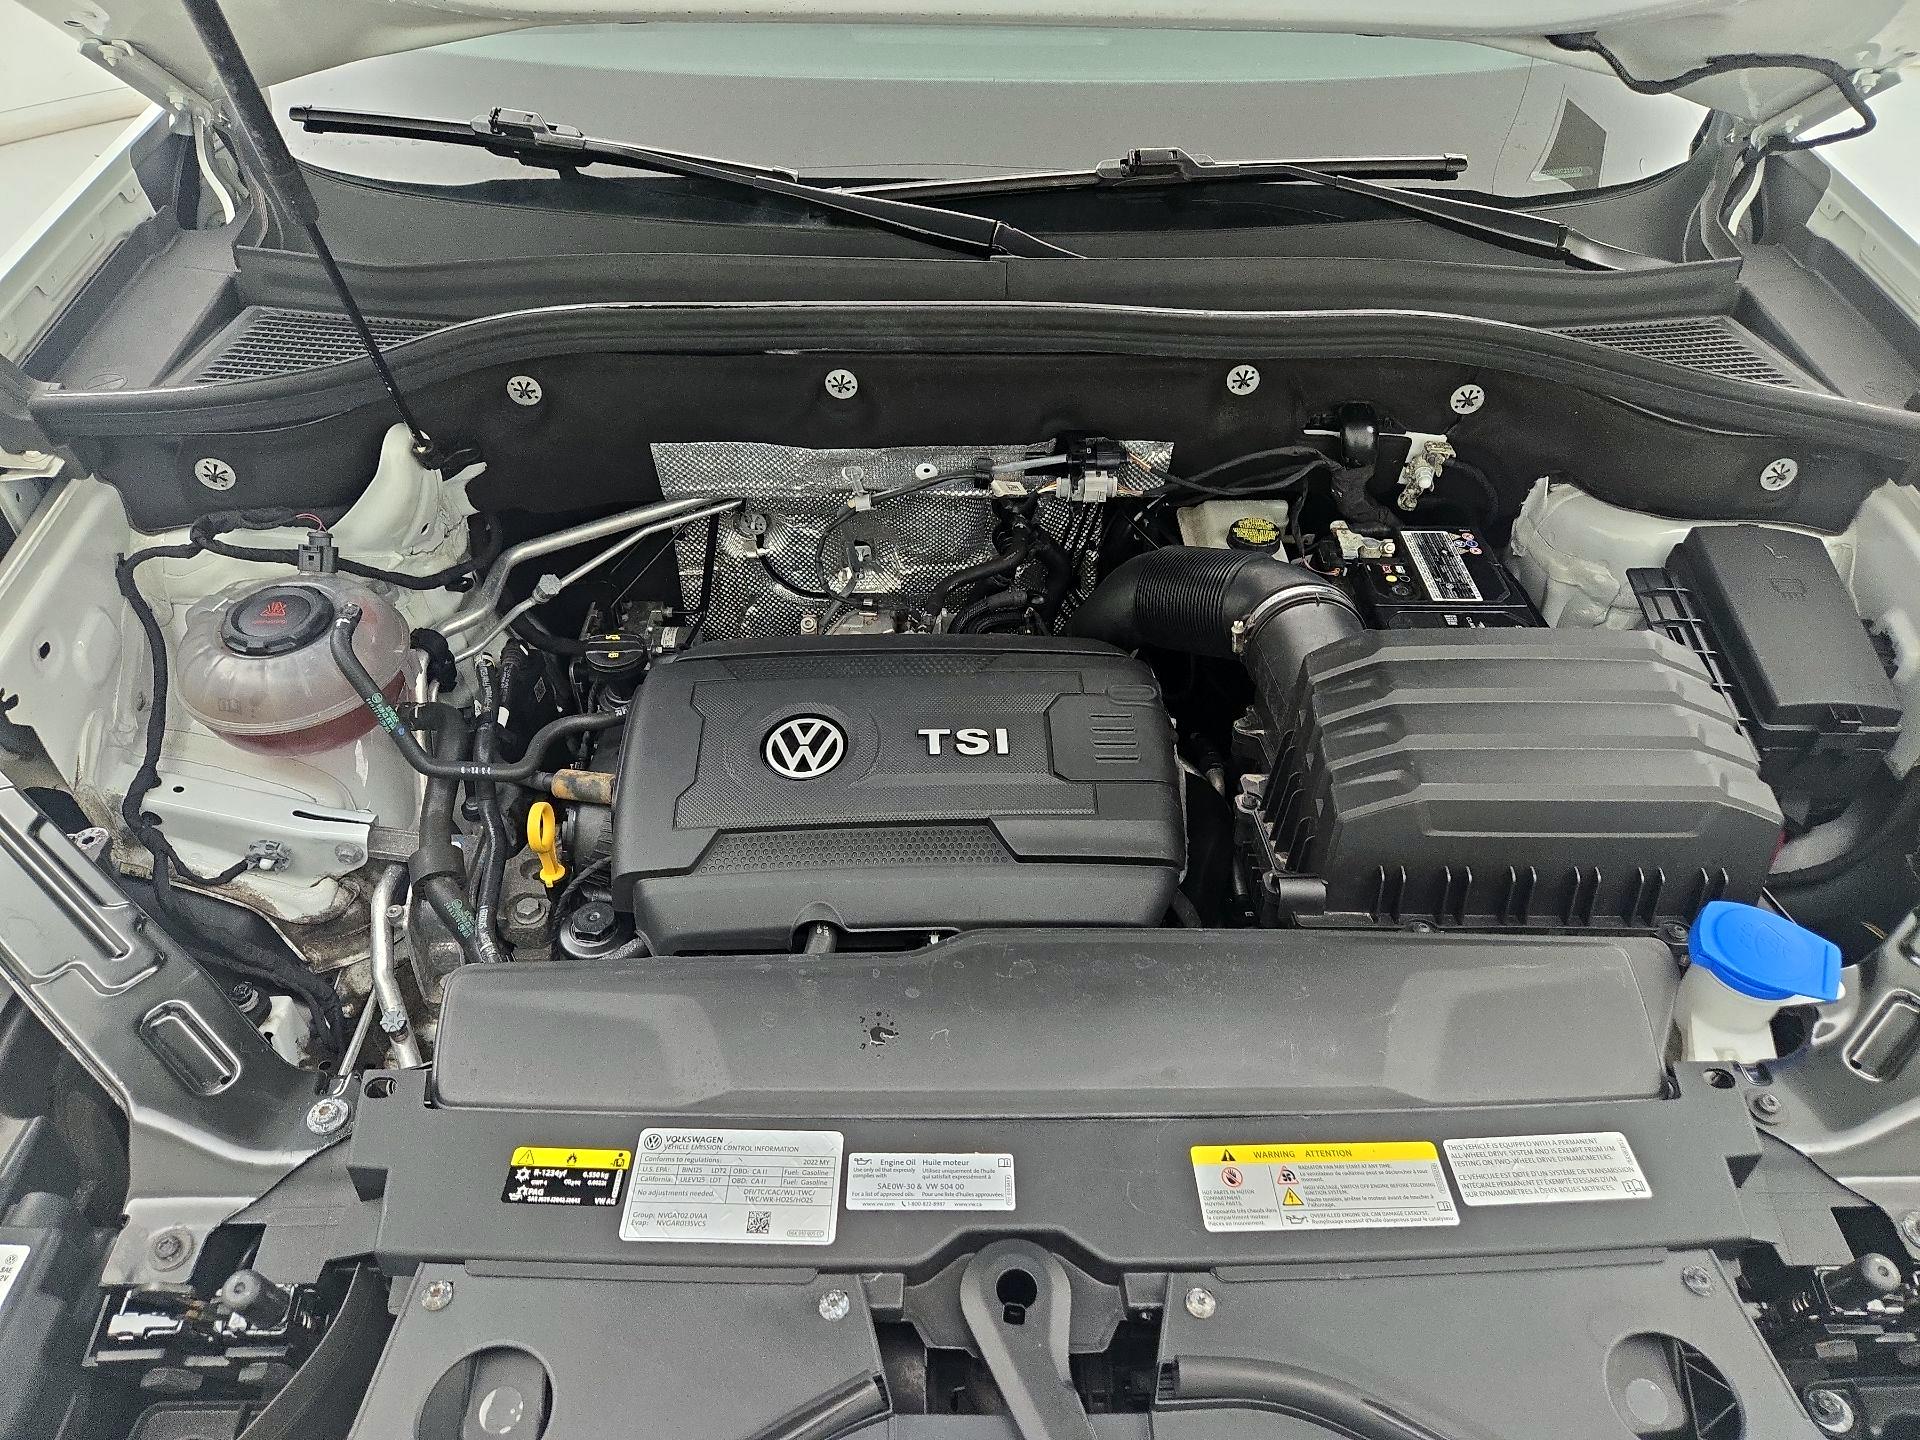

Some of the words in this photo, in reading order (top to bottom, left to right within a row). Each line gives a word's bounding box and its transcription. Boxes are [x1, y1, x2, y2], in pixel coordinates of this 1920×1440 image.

[917, 728, 1009, 755] TSI
[1499, 1141, 1531, 1149] EQUIPPED
[1558, 1138, 1598, 1146] PERMANENT
[1253, 1150, 1296, 1158] WARNING
[1305, 1149, 1352, 1158] ATTENTION
[880, 1159, 904, 1167] Engine
[1586, 1166, 1634, 1174] TRANSMISSION
[648, 1190, 688, 1198] adjustments
